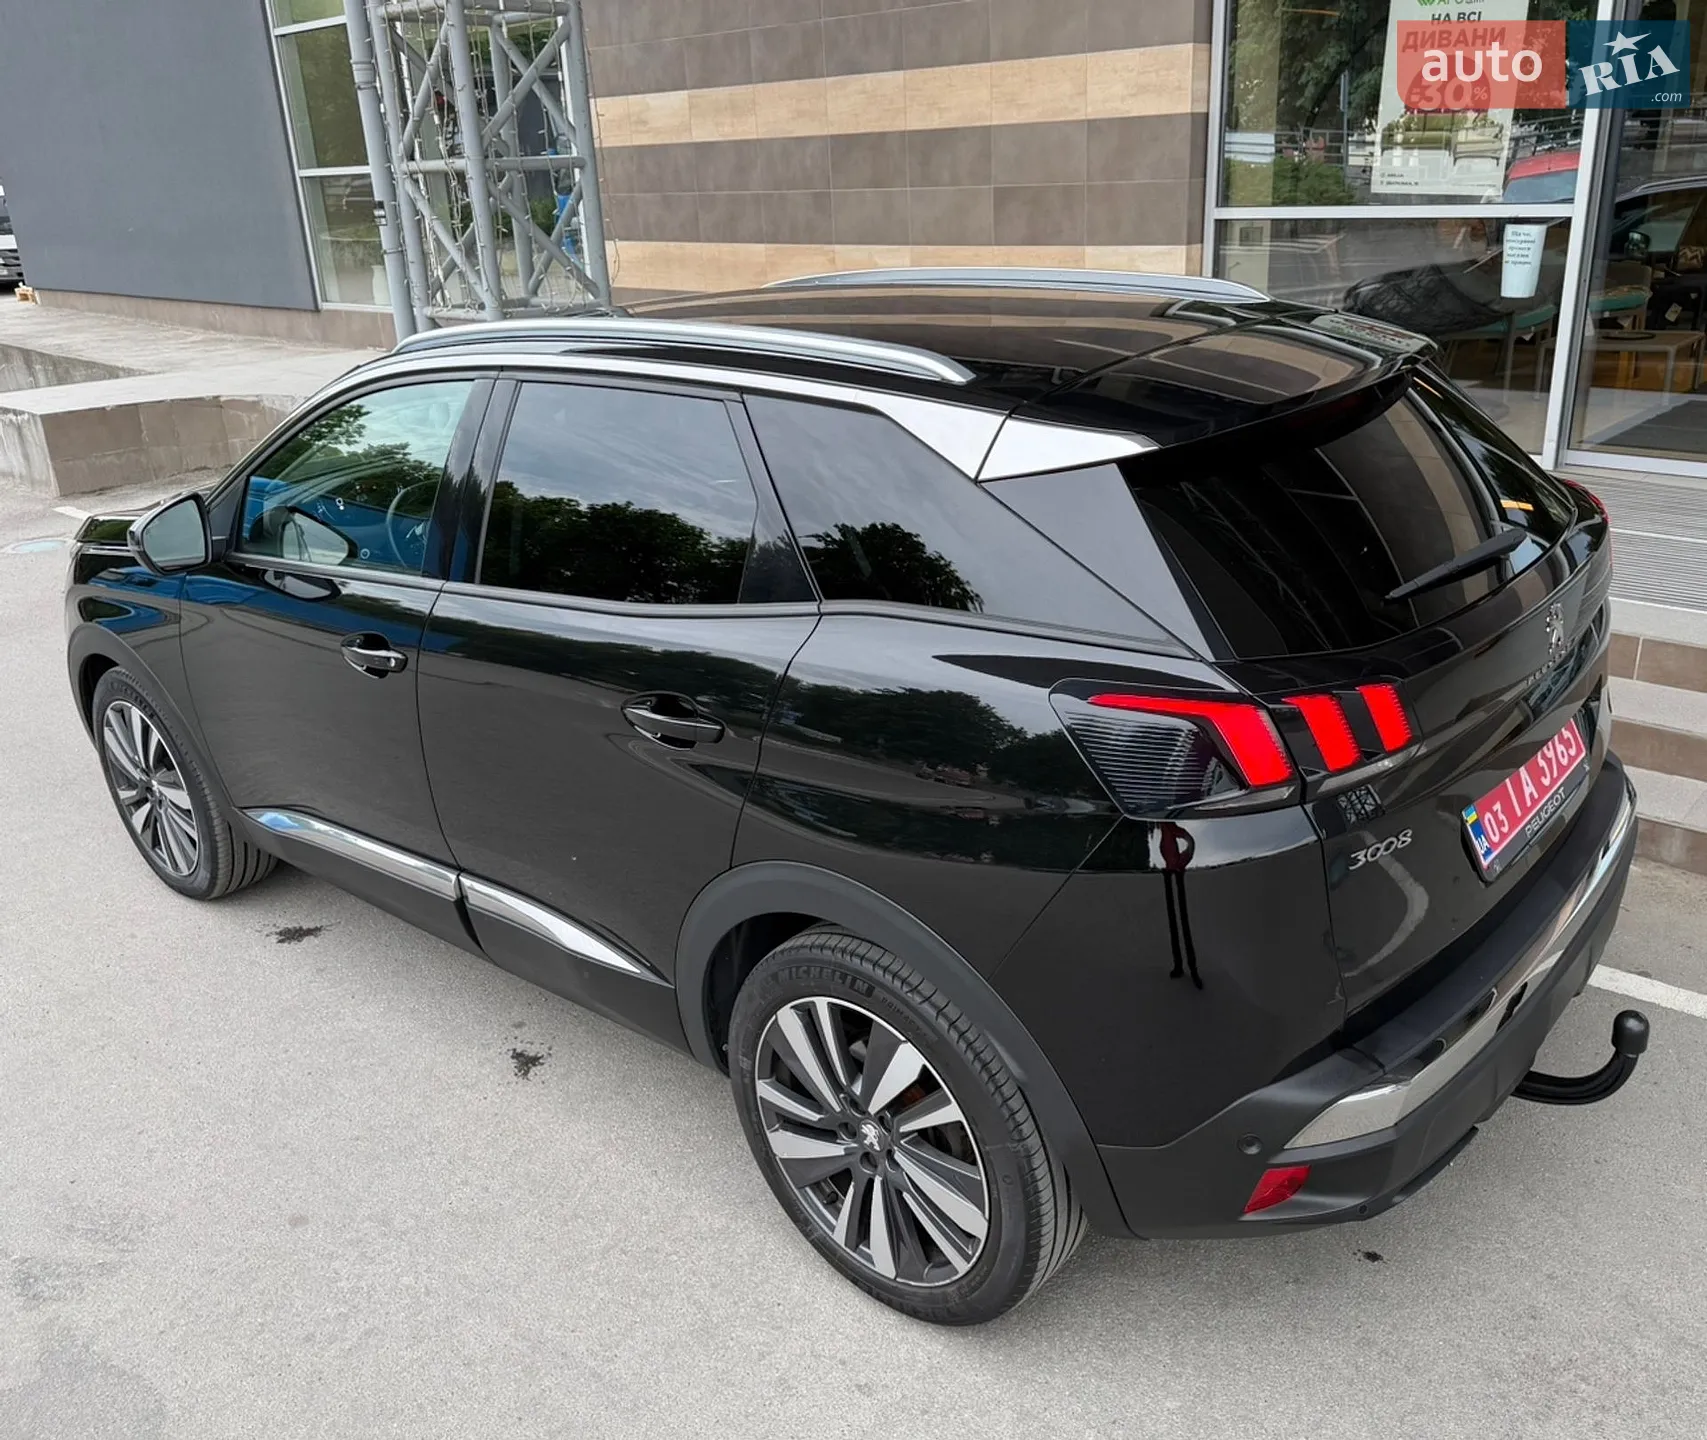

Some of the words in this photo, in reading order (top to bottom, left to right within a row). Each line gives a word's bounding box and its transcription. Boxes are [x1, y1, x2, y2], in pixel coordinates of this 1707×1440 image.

[1430, 13, 1452, 25] НА
[1456, 11, 1482, 23] ВСІ
[1402, 27, 1506, 52] ДИВАНИ
[1483, 801, 1509, 843] 03
[1525, 786, 1566, 838] PEUGEOT
[1348, 828, 1413, 870] 3008
[777, 965, 868, 994] MICHELIN
